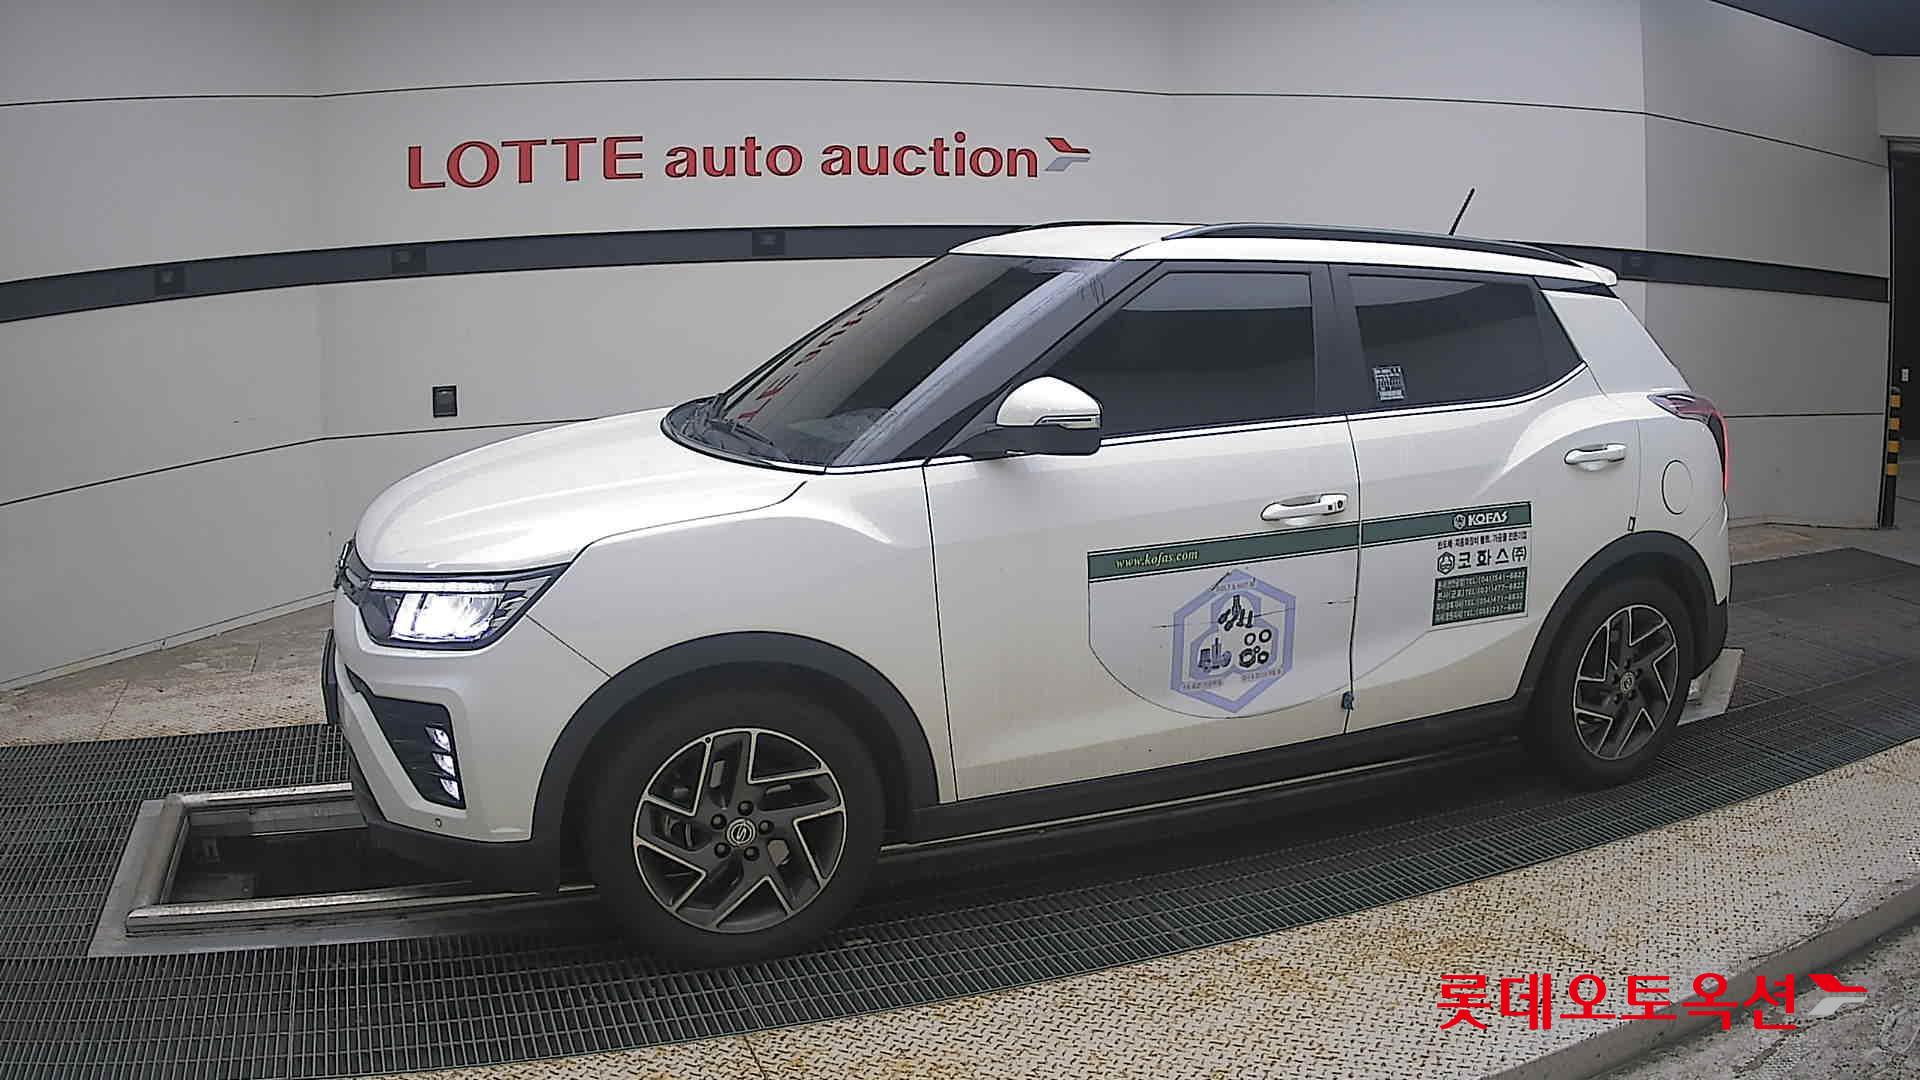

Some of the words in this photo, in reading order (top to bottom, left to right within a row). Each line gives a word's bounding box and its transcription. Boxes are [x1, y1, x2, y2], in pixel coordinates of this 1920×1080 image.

[407, 135, 643, 190] LOTTE
[664, 136, 803, 178] auto
[820, 131, 1038, 179] auction
[1114, 549, 1199, 569] www.kofas.com
